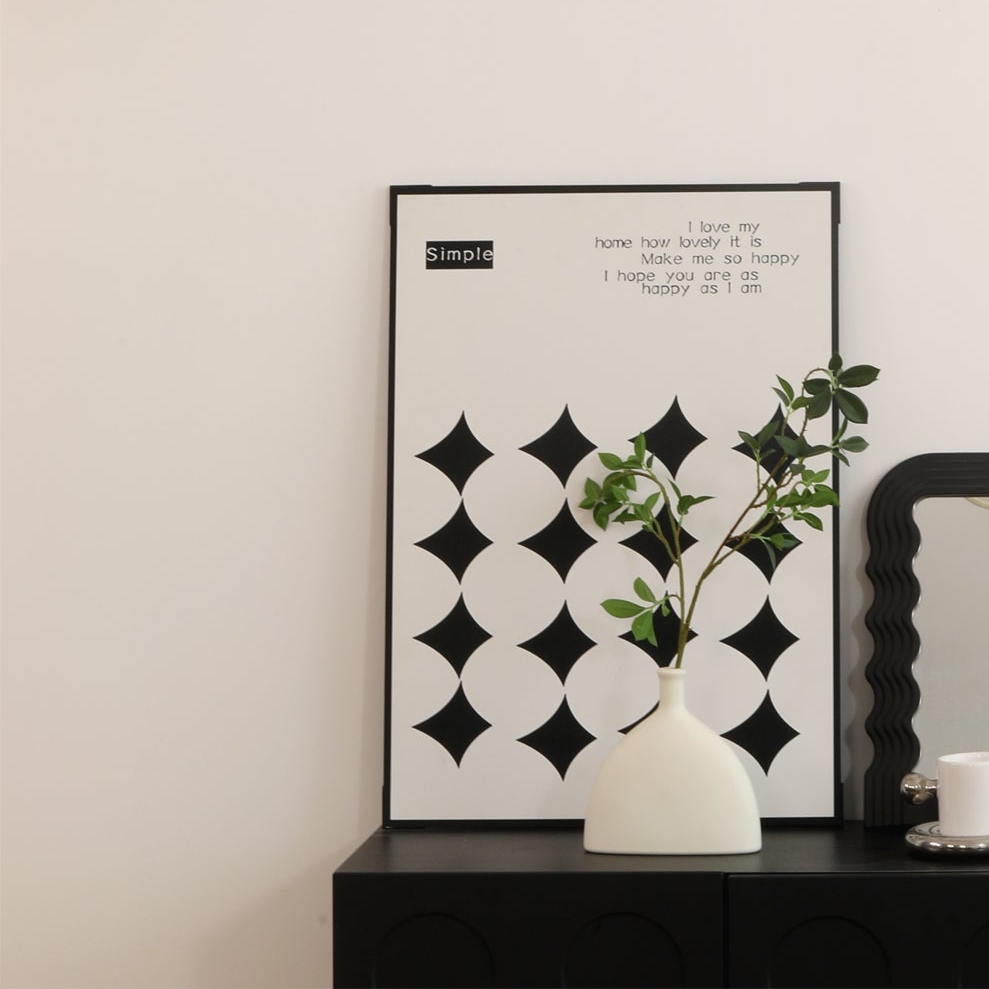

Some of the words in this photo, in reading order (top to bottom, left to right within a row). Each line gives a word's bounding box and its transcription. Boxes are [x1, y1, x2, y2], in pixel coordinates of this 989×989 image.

[688, 221, 692, 233] I
[700, 221, 731, 233] love
[739, 223, 760, 234] my
[595, 236, 633, 249] home
[641, 236, 671, 248] how
[680, 236, 721, 250] lovely
[730, 235, 741, 248] it
[750, 235, 762, 248] is
[427, 246, 493, 264] Simple
[641, 252, 683, 265] Make
[692, 255, 714, 265] me
[723, 254, 743, 265] so
[752, 252, 800, 267] happy
[604, 270, 608, 282] I
[617, 270, 656, 283] hope
[665, 271, 695, 283] you
[704, 271, 732, 281] are
[740, 271, 759, 281] as
[641, 282, 691, 297] happy
[700, 284, 719, 295] as
[727, 281, 732, 294] I
[740, 284, 763, 294] am
